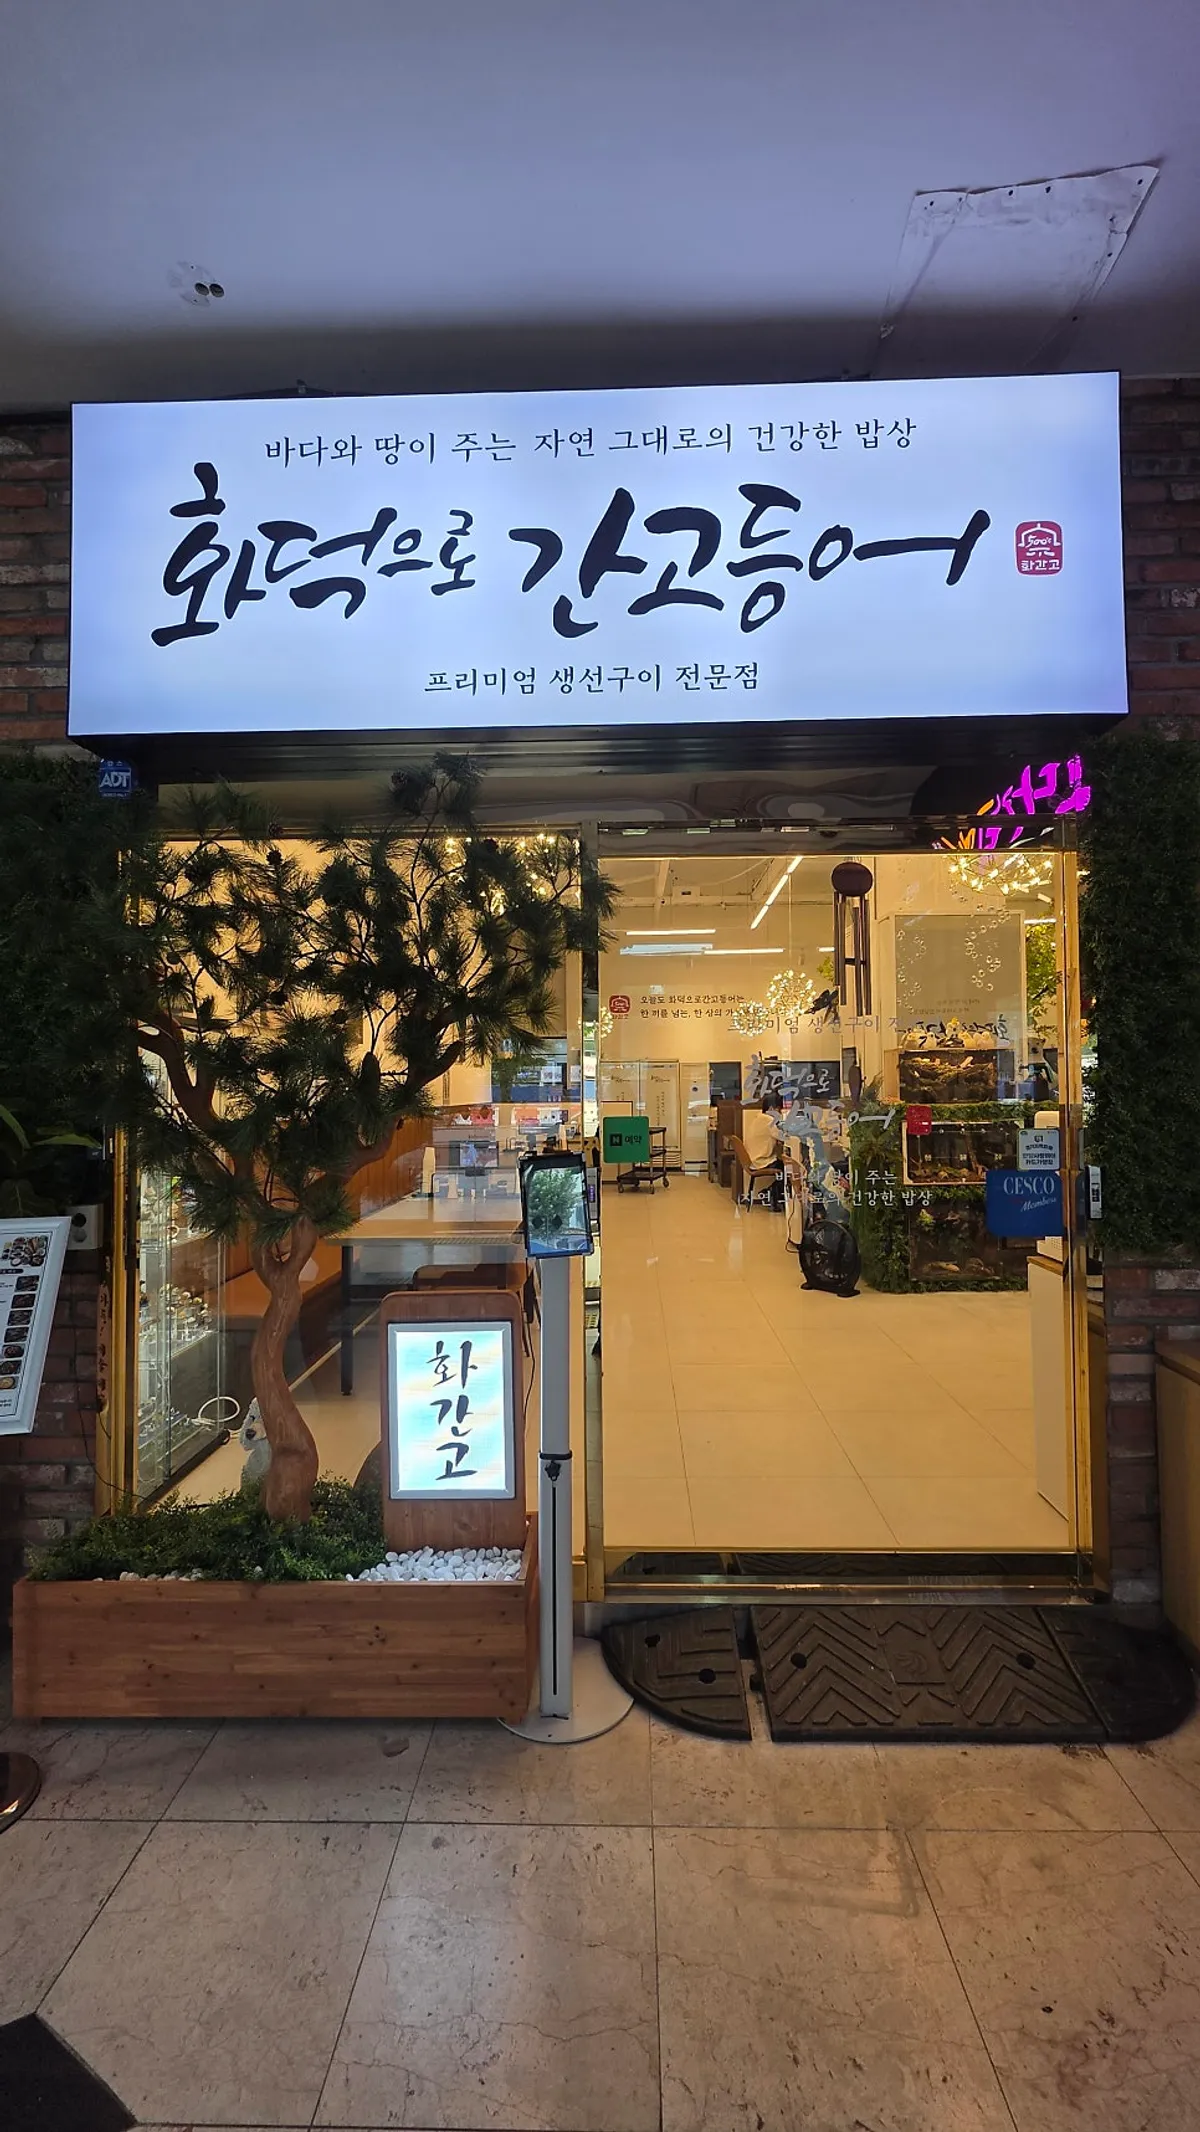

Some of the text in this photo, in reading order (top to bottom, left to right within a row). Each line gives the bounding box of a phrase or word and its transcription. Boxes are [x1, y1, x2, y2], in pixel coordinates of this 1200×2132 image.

[266, 417, 917, 468] 바다와 땅이 주는 자연 그대로의 건강한 밥상
[151, 462, 991, 647] 화덕으로 간고등어
[1021, 559, 1060, 572] 화간고
[424, 661, 758, 696] 프리미엄 생선구이 전문점
[100, 771, 130, 788] ADT
[740, 1051, 831, 1106] 화덕으로
[866, 1170, 898, 1186] 주는
[1003, 1177, 1055, 1194] CESCO
[849, 1190, 896, 1207] 건강한
[902, 1190, 933, 1207] 밥상
[426, 1340, 478, 1481] 화간고
